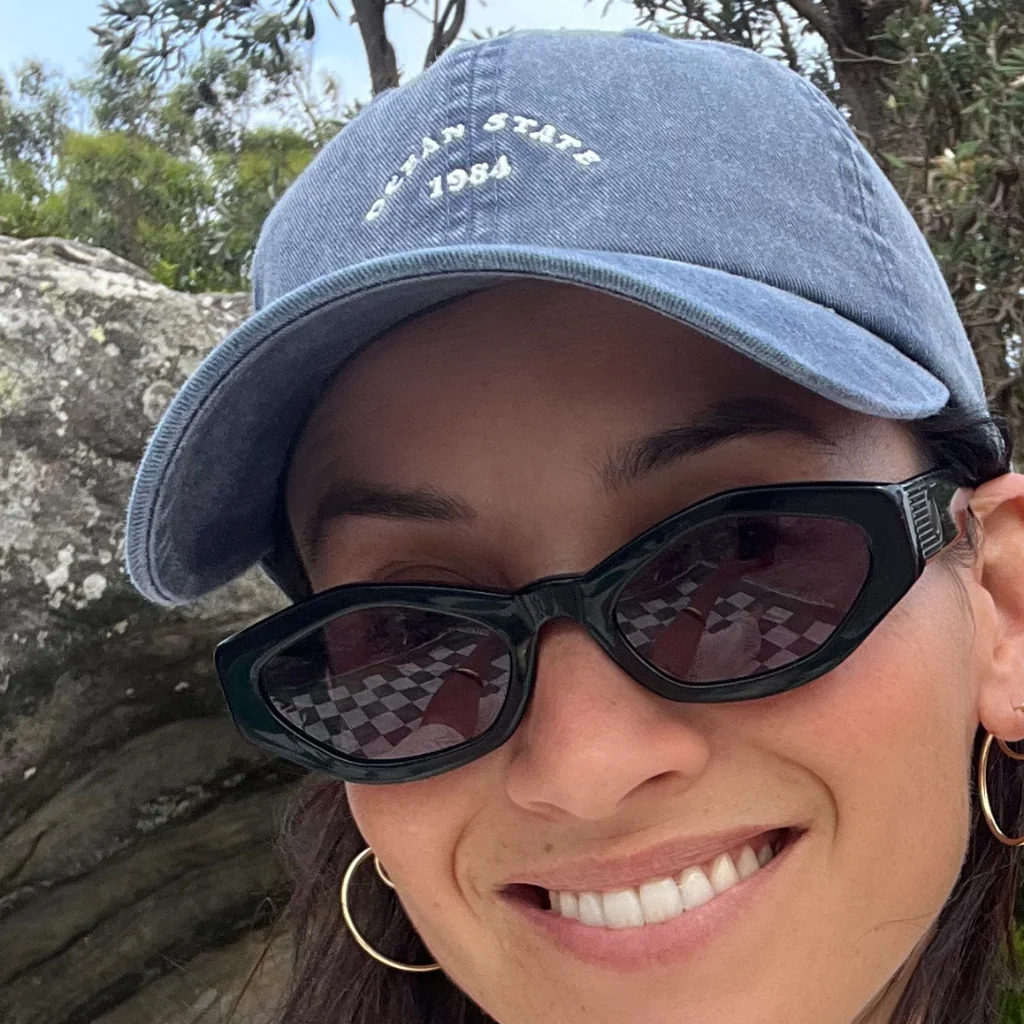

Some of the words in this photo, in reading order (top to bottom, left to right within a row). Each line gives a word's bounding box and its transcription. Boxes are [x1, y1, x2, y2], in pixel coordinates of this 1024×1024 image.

[364, 123, 466, 222] OCEAN
[483, 112, 601, 166] STATE
[428, 154, 512, 199] 1984
